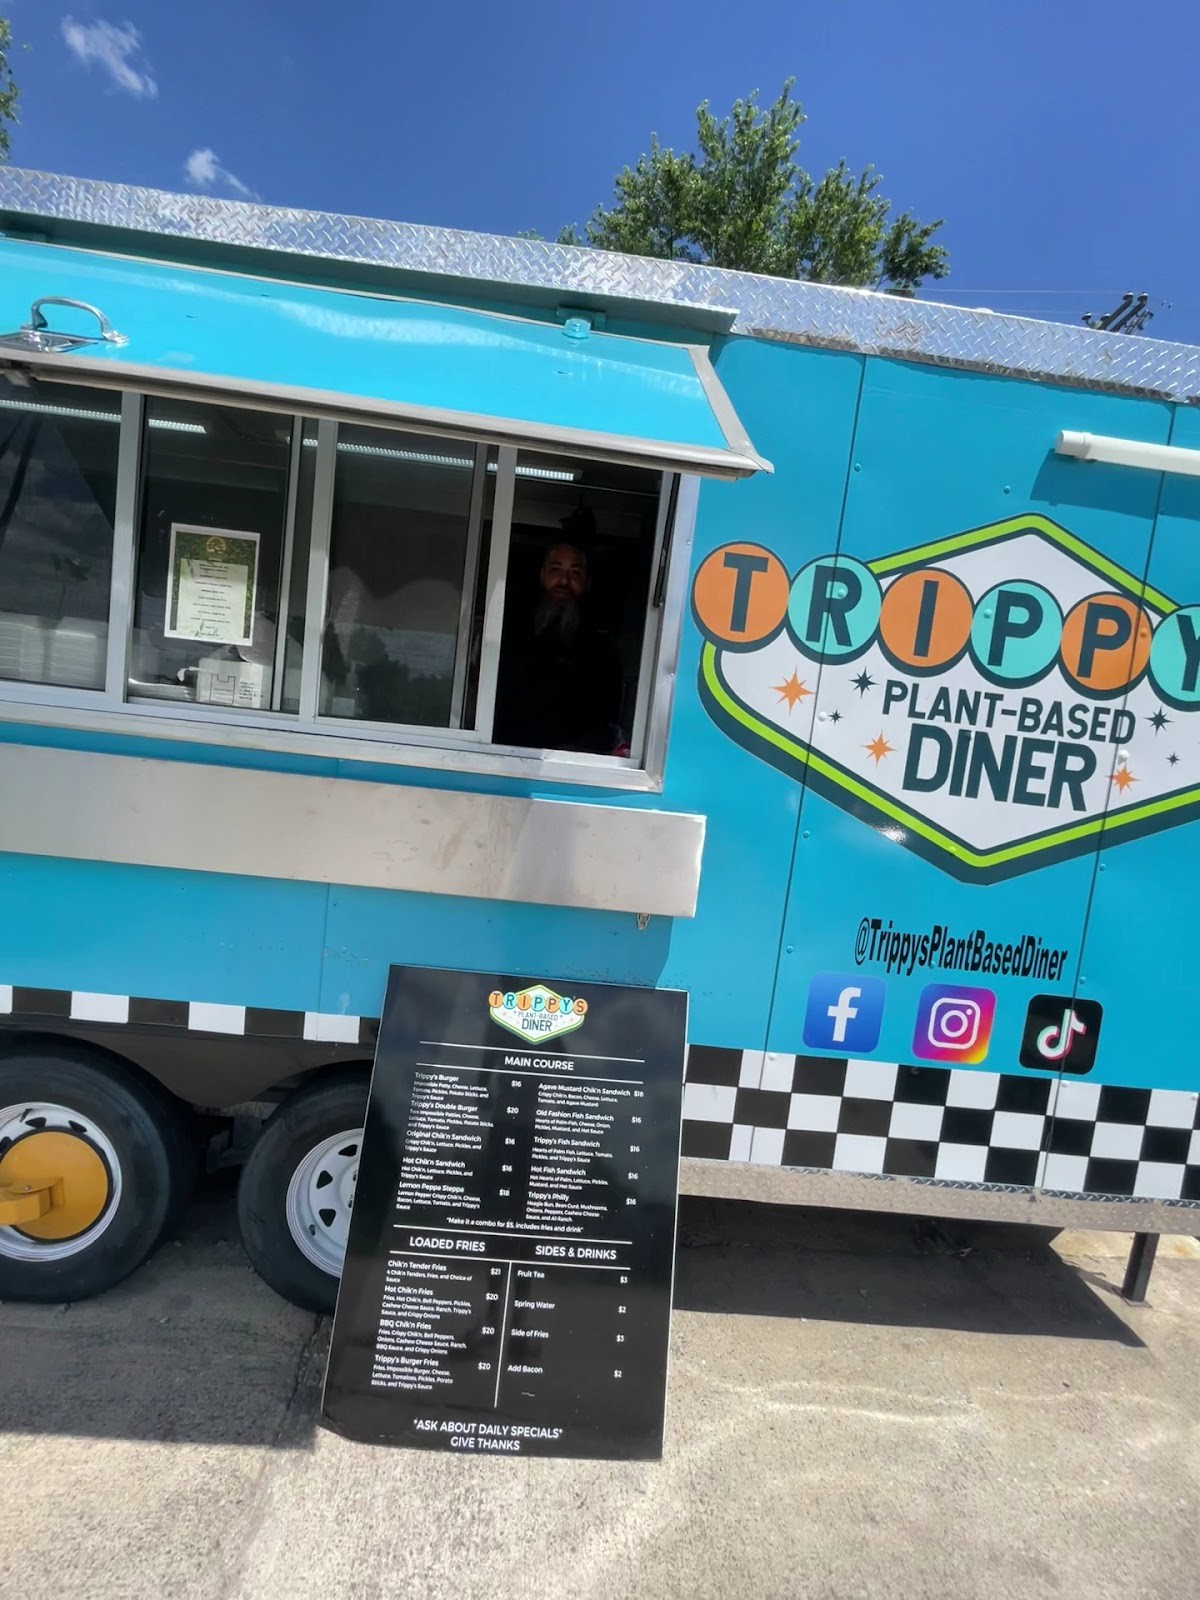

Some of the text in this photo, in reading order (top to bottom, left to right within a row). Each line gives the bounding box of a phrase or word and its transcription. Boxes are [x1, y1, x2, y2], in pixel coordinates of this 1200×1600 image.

[881, 679, 1137, 745] PLANT-BASED
[902, 722, 1098, 812] DINER
[855, 917, 1068, 981] @TrippysPlantBasedDiner
[493, 993, 584, 1013] TRIPPYS
[518, 1011, 558, 1020] PLANT-BASED
[522, 1018, 552, 1032] DINER
[505, 1056, 574, 1070] MAIN COURSE
[416, 1072, 437, 1081] Trippy's
[539, 1083, 557, 1091] Agave
[558, 1085, 582, 1093] Mustard
[411, 1101, 434, 1109] Trippy's
[507, 1106, 519, 1114] $20
[585, 1113, 614, 1121] Sandwich
[407, 1130, 430, 1138] Original
[451, 1134, 481, 1142] Sandwich
[534, 1136, 556, 1145] Trippy's
[415, 1158, 434, 1166] Chik'n
[435, 1160, 465, 1168] Sandwich
[557, 1168, 586, 1176] Sandwich
[422, 1183, 441, 1191] Peppa
[443, 1185, 464, 1193] Steppa
[528, 1192, 569, 1202] Trippy's Philly
[516, 1222, 540, 1230] includes
[410, 1236, 485, 1252] LOADED FRIES
[536, 1245, 617, 1260] SIDES & DRINKS
[388, 1260, 408, 1268] Chik'n
[409, 1262, 431, 1270] Tender
[518, 1270, 532, 1278] Fruit
[397, 1287, 417, 1295] Chik'n
[514, 1300, 535, 1309] Spring
[380, 1319, 431, 1330] BBQ Chik'n Fries
[482, 1326, 494, 1335] $20
[534, 1330, 549, 1338] Fries
[375, 1355, 399, 1364] Trippy's
[401, 1357, 422, 1365] Burger
[478, 1362, 491, 1370] $20
[440, 1421, 477, 1433] ABOUT
[479, 1424, 508, 1436] DAILY
[451, 1437, 520, 1450] GIVE THANKS
